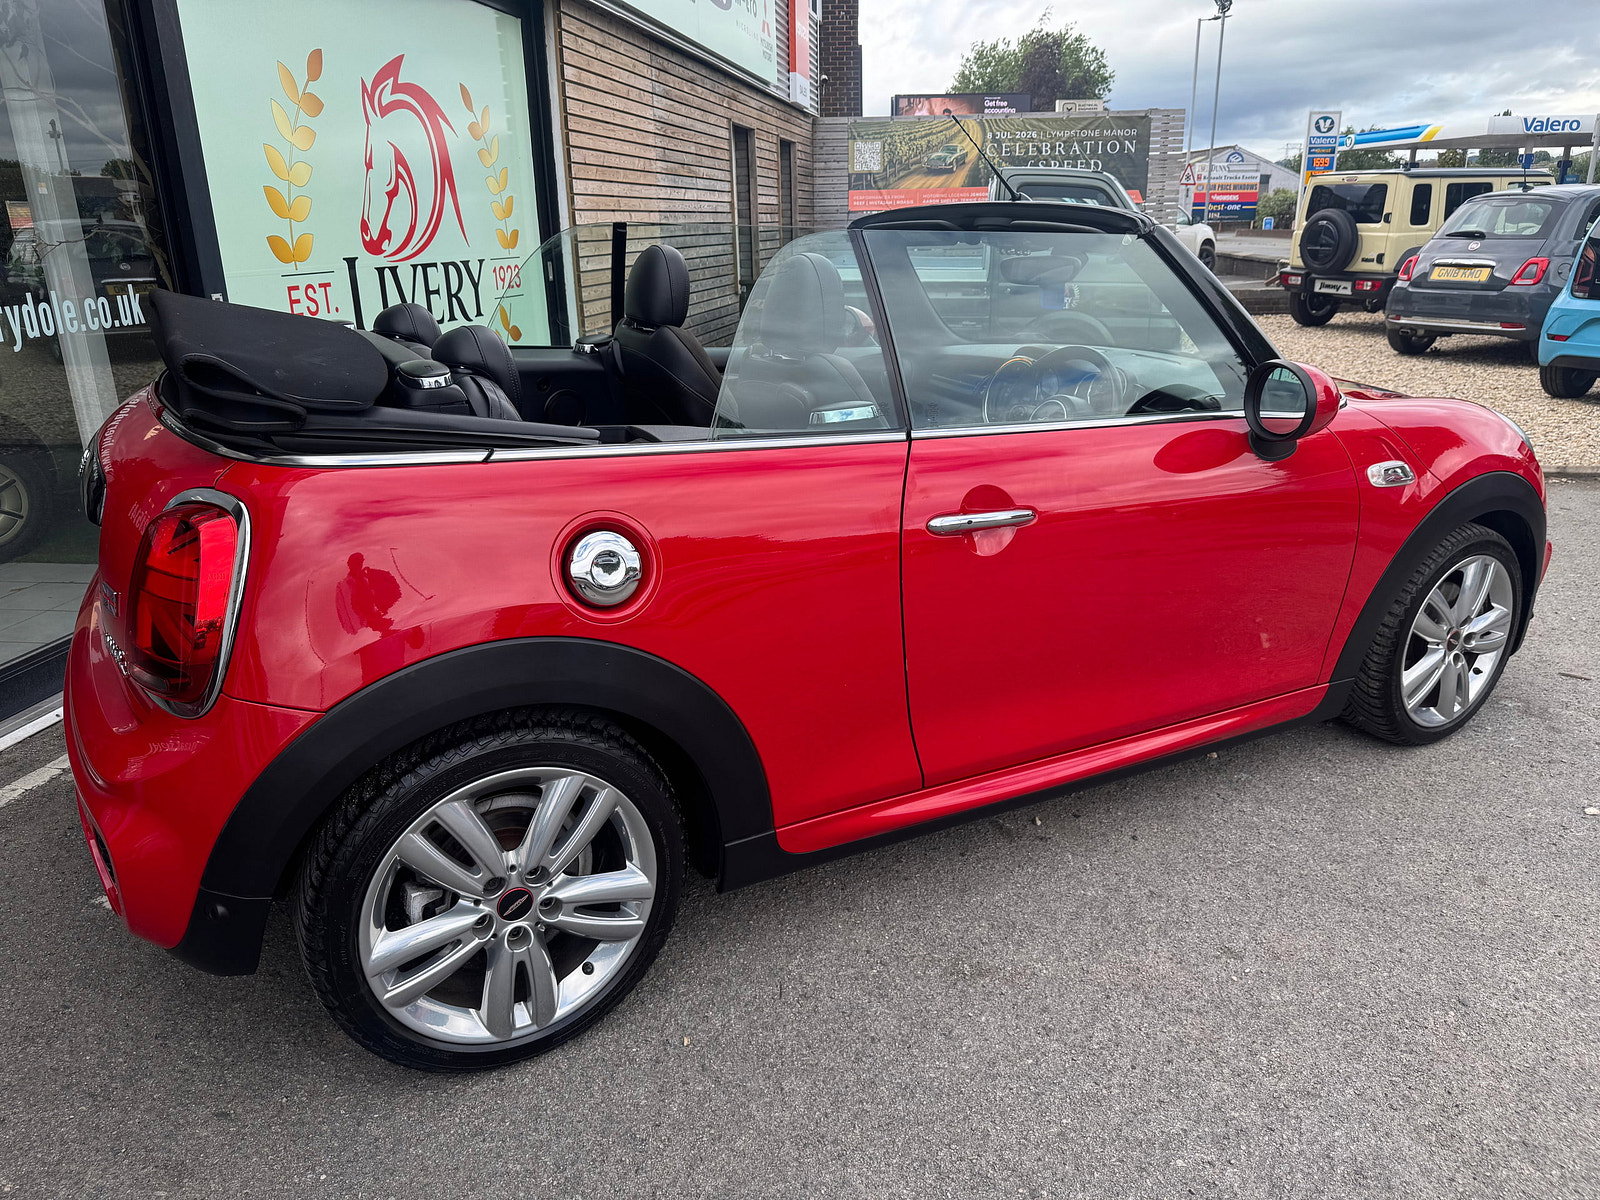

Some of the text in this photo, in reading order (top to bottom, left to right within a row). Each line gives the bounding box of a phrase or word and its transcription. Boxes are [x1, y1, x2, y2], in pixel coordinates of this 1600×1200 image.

[995, 131, 1013, 139] JUL
[1016, 130, 1038, 138] 2026
[1046, 129, 1100, 138] LYMPSTONE
[1103, 128, 1138, 136] MANOR
[1523, 117, 1581, 132] Valero
[986, 140, 1137, 157] CELEBRATION
[492, 264, 522, 290] 1923
[287, 282, 340, 316] EST.
[343, 257, 486, 330] LIVERY
